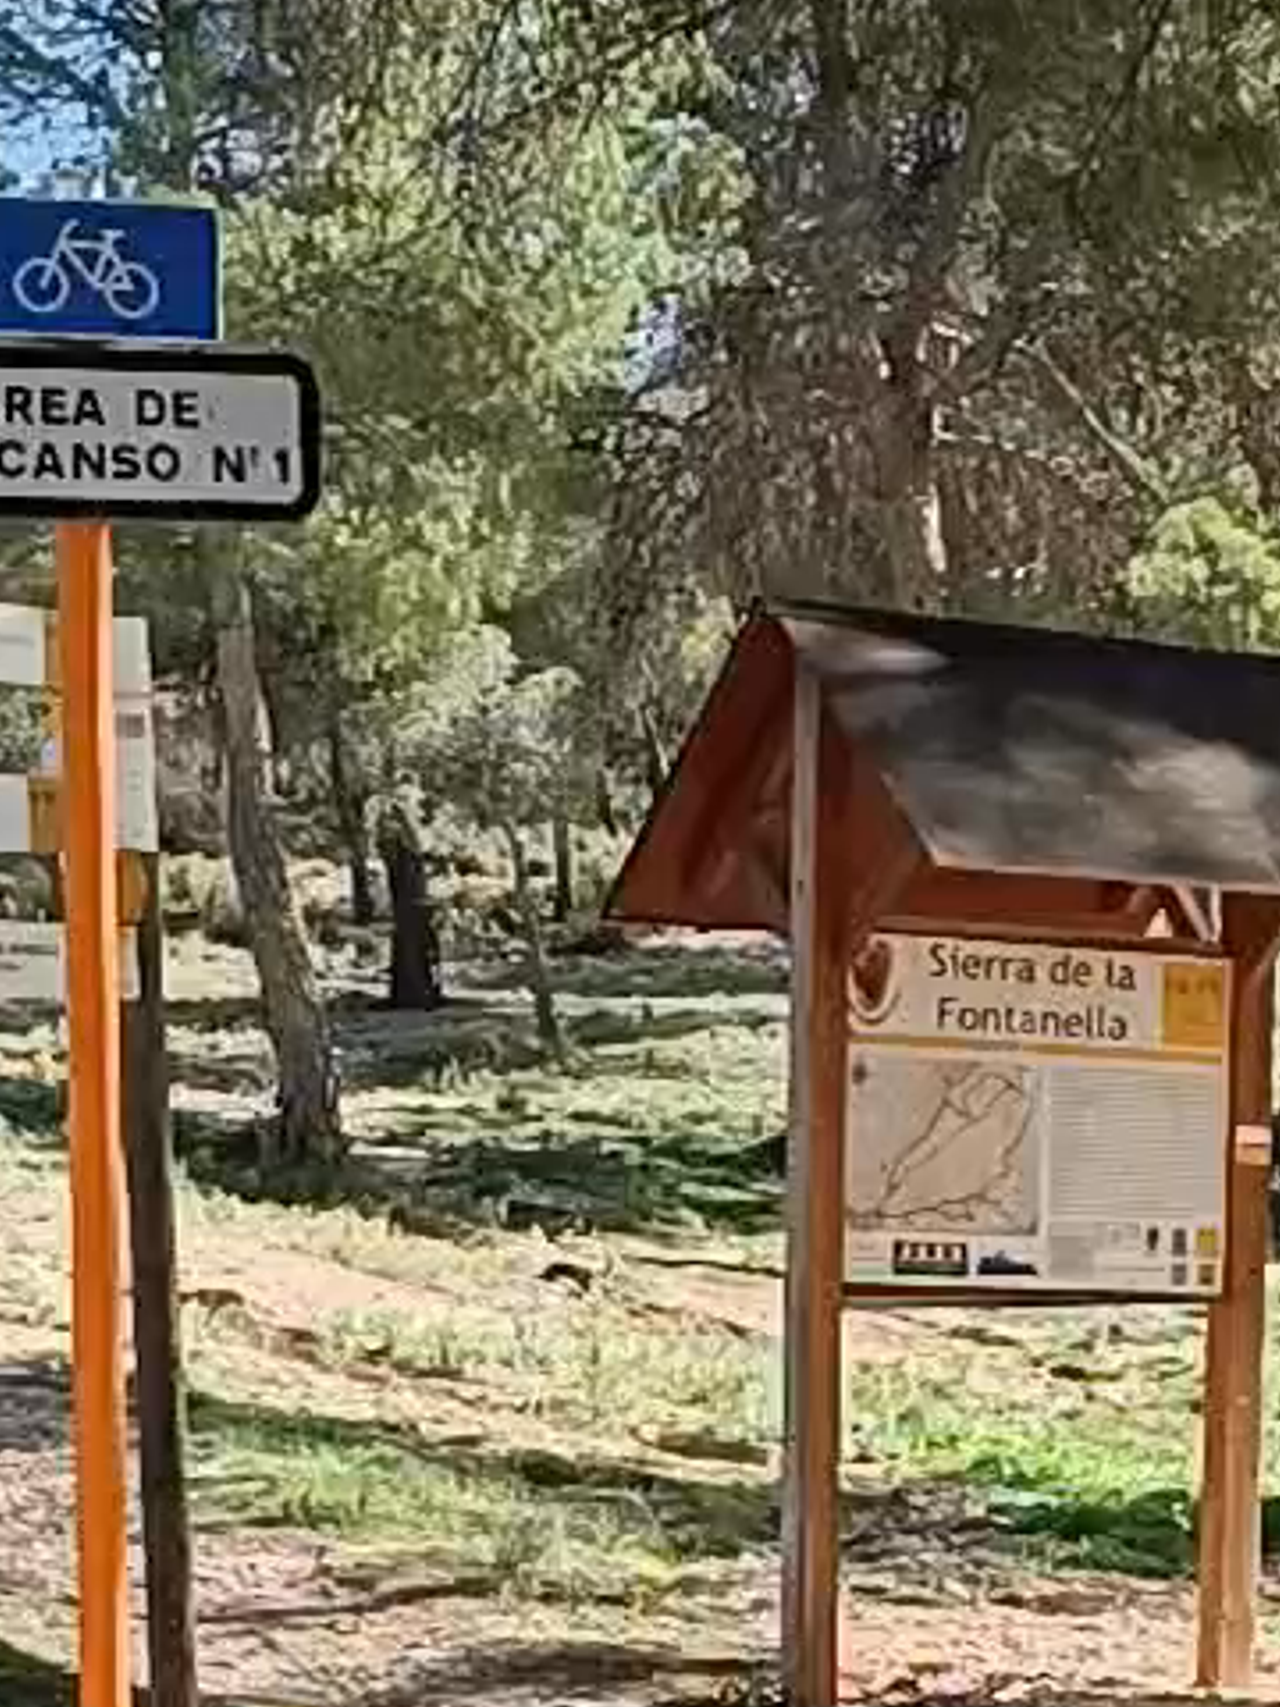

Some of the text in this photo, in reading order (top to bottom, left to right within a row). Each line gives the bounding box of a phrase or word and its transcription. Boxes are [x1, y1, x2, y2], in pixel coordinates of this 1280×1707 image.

[135, 389, 200, 428] DE
[928, 942, 1037, 984] Sierra
[1048, 953, 1094, 988] de
[1105, 961, 1138, 992] la
[935, 996, 1129, 1042] Fontanella
